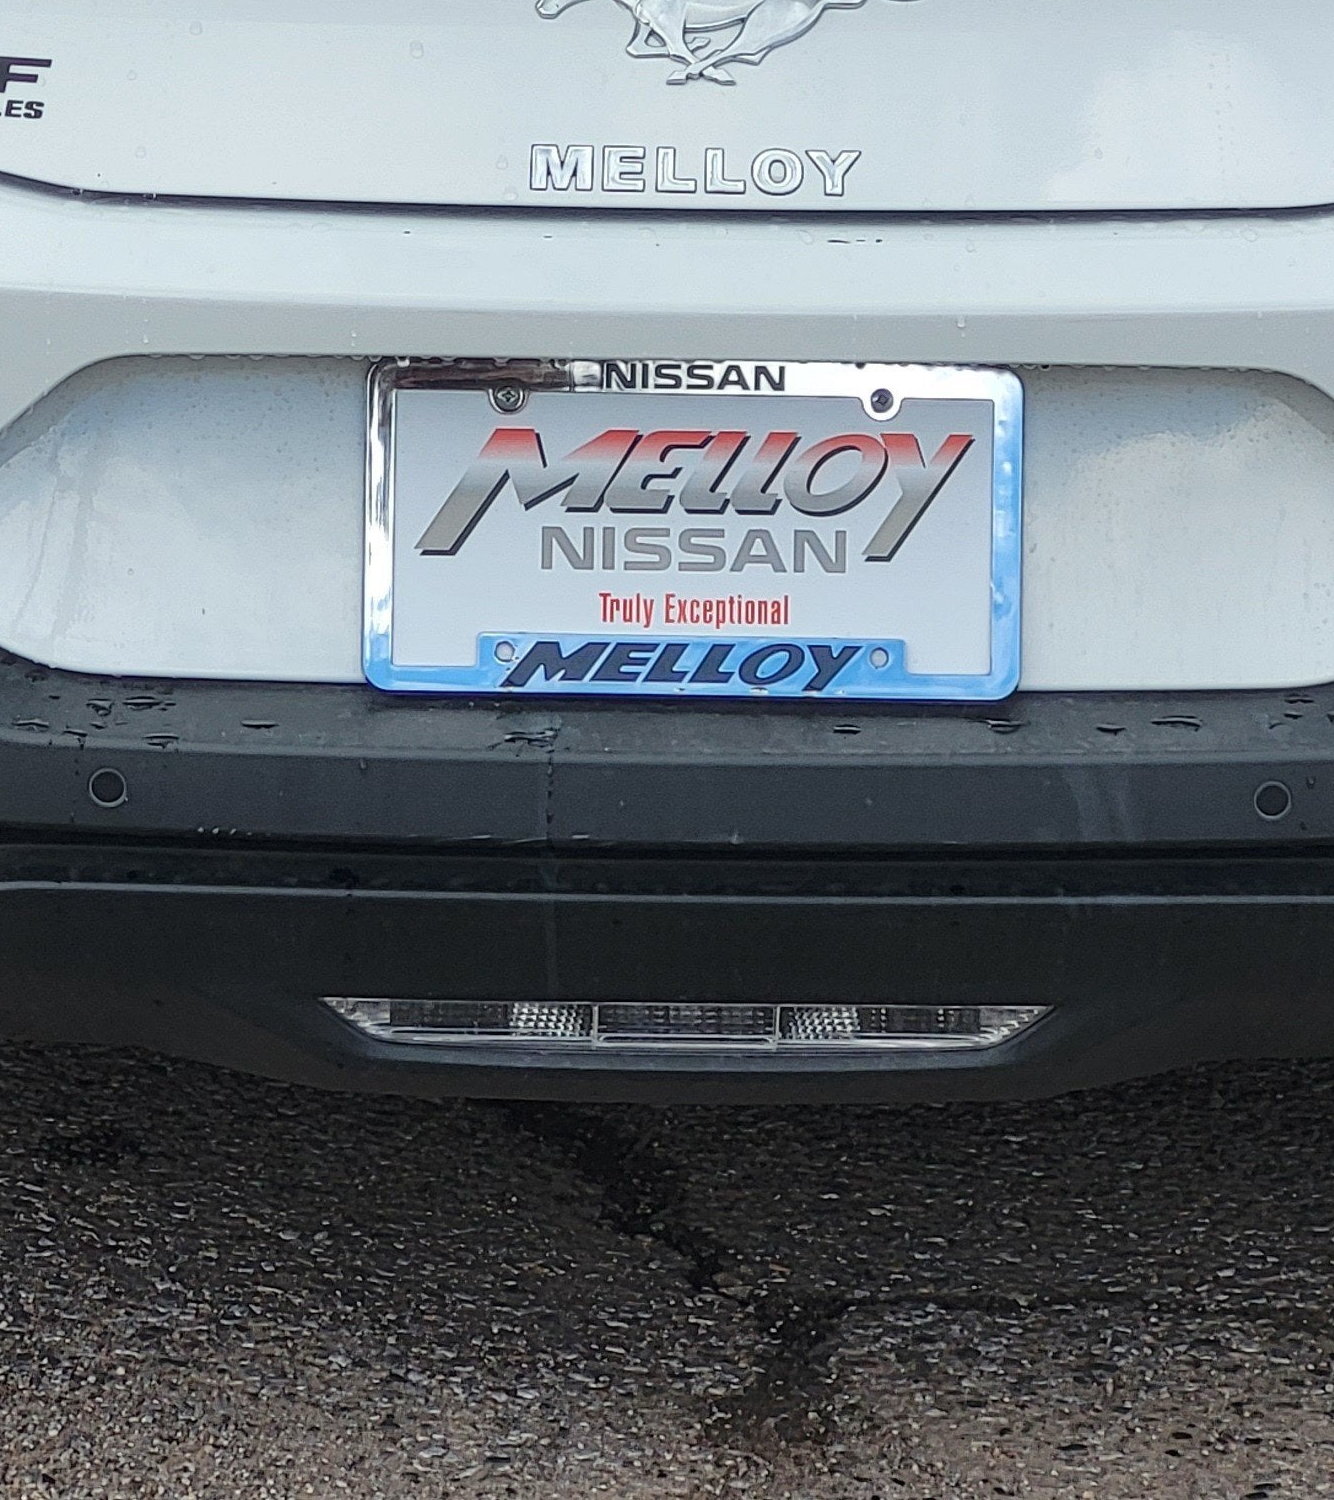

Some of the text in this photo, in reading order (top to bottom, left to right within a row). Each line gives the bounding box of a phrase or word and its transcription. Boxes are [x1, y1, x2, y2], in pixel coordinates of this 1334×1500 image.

[529, 143, 862, 198] MELLOY
[603, 363, 785, 392] NISSAN
[414, 428, 975, 562] MELLOY
[541, 526, 847, 574] NISSAN
[598, 592, 789, 629] Truly Exceptional
[503, 641, 863, 690] MELLOY
